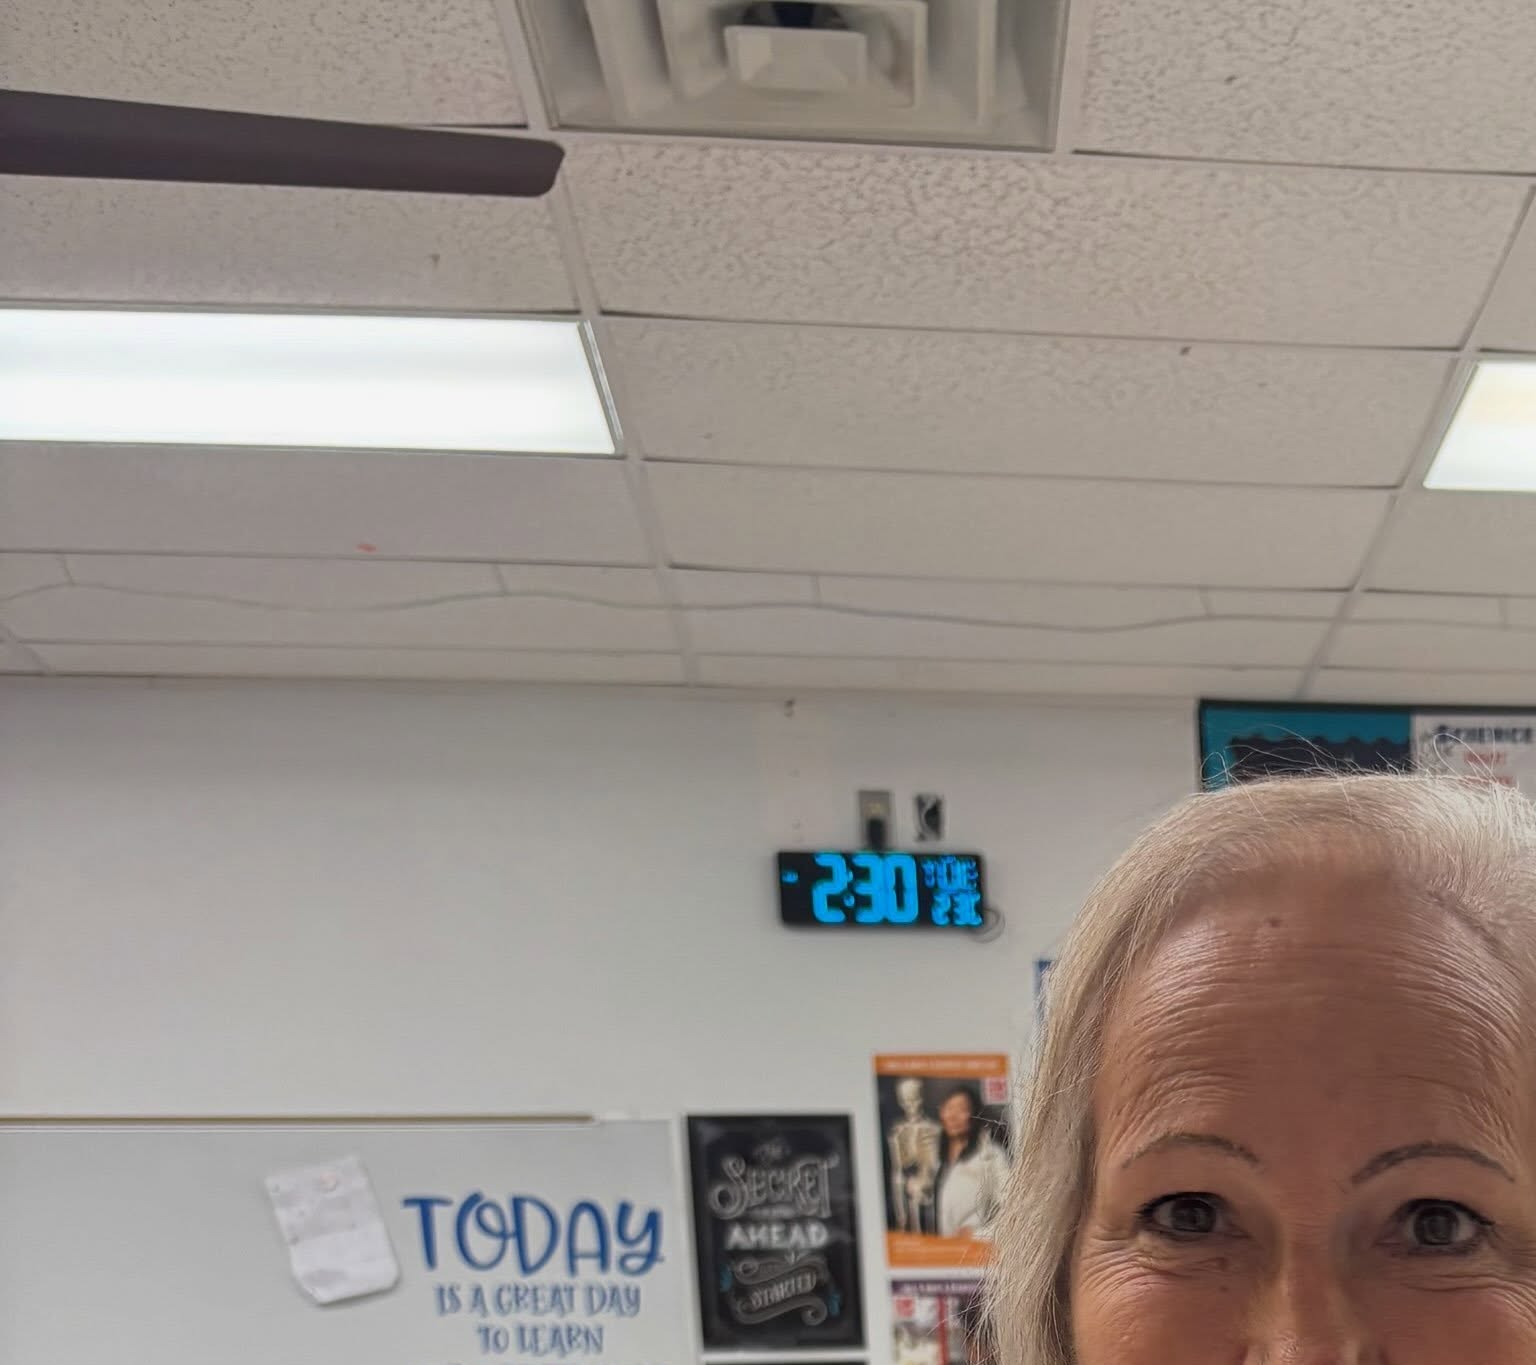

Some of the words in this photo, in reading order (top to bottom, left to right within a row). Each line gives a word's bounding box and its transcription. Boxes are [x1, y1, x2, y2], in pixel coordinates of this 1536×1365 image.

[812, 852, 919, 925] 2:30
[707, 1153, 841, 1220] SECRET
[403, 1191, 665, 1278] TODAY
[726, 1221, 829, 1250] AHEAD
[435, 1284, 463, 1317] IS
[469, 1284, 490, 1318] A
[495, 1284, 577, 1318] GREAT
[584, 1284, 643, 1318] DAY
[477, 1324, 510, 1355] TO
[516, 1323, 605, 1358] LEARN
